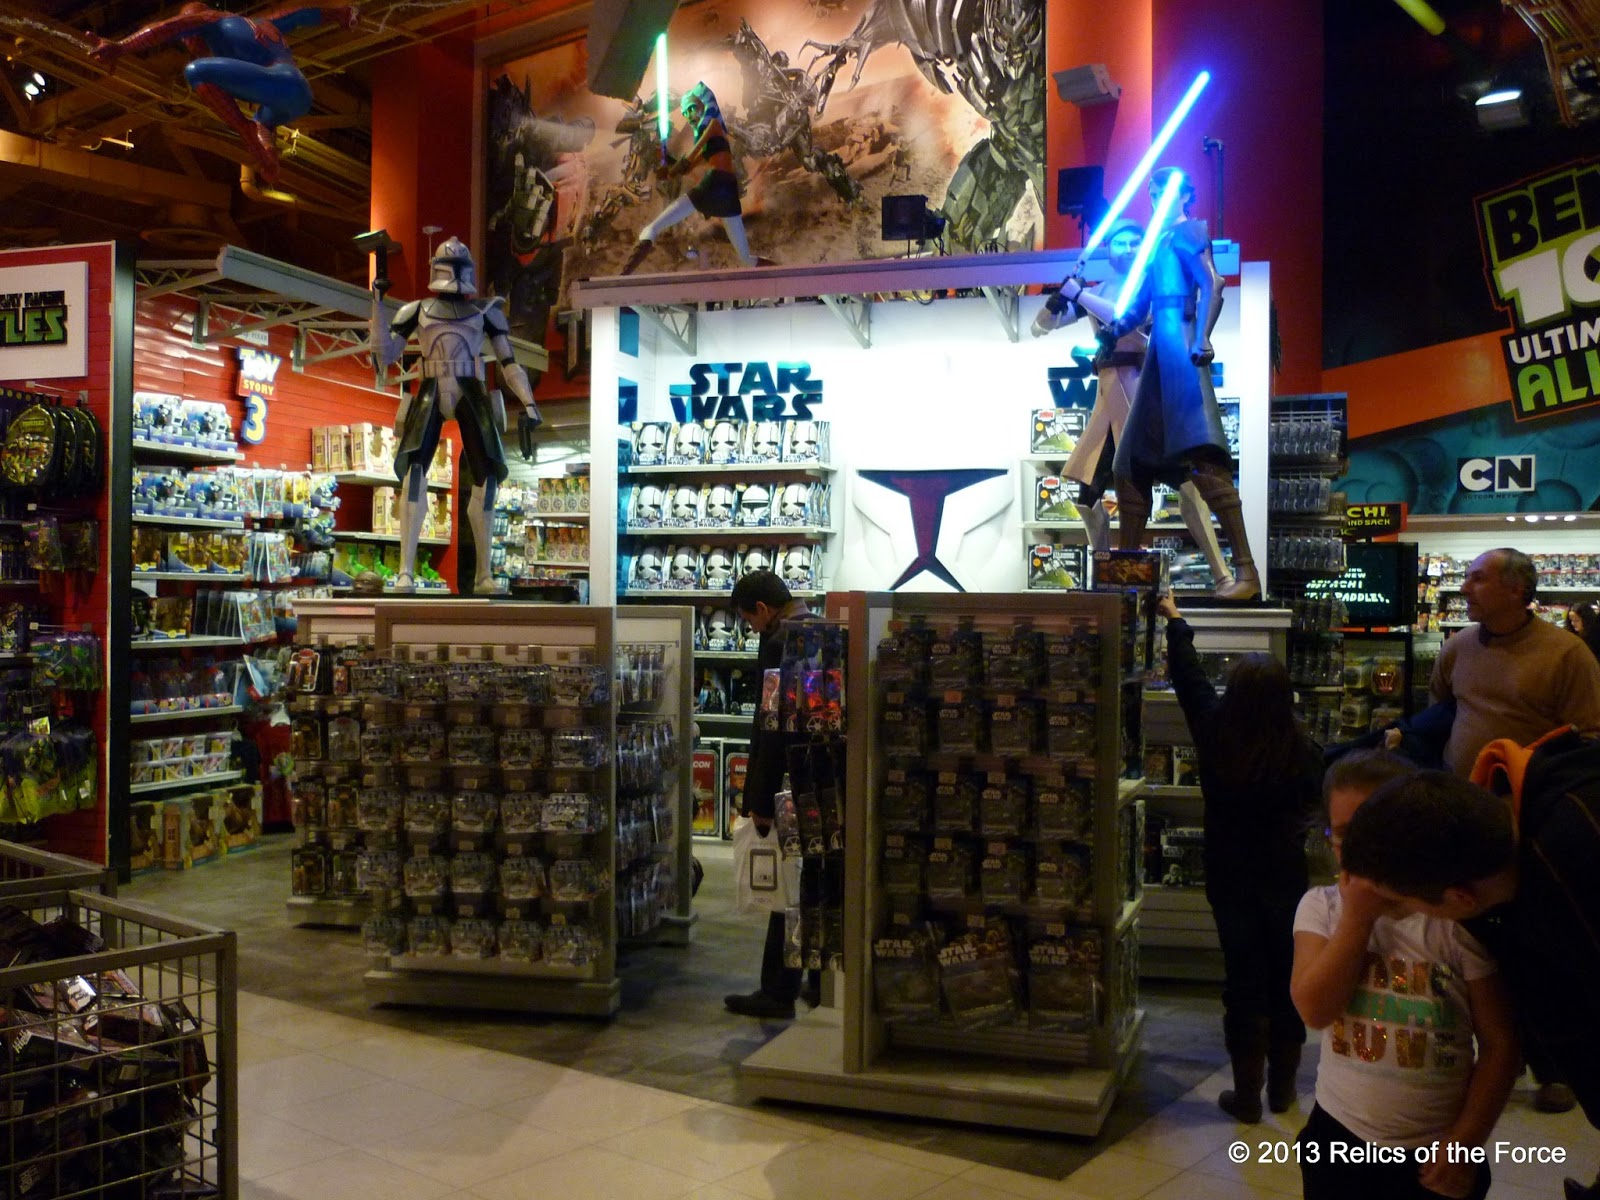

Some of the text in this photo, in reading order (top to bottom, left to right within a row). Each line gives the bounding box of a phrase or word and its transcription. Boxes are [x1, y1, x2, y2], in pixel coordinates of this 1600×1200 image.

[239, 347, 281, 382] TOY
[669, 362, 823, 396] STAR
[243, 379, 275, 396] STORY
[244, 393, 267, 442] 3
[669, 393, 823, 423] WARS
[1459, 455, 1535, 492] CN
